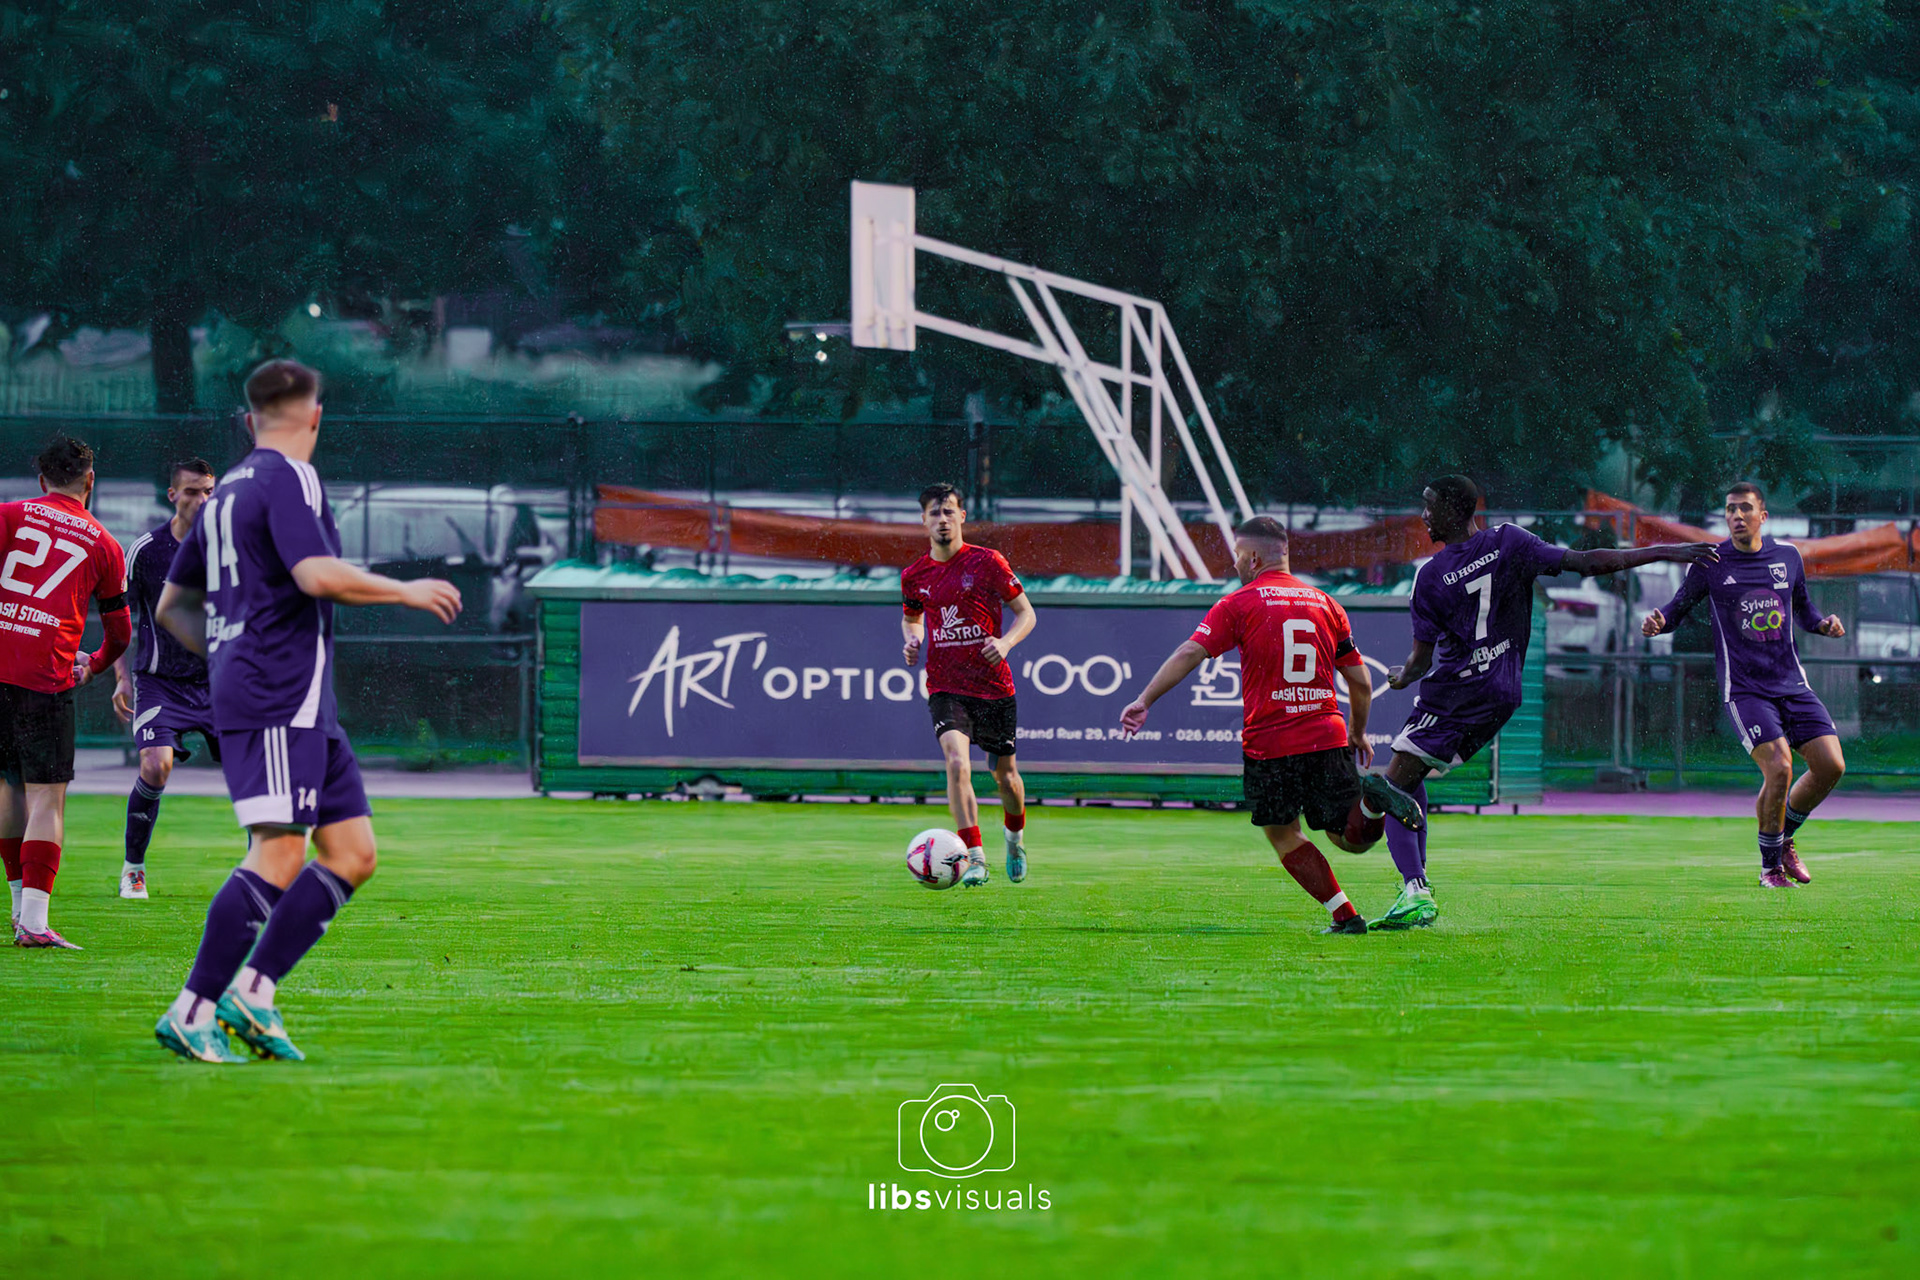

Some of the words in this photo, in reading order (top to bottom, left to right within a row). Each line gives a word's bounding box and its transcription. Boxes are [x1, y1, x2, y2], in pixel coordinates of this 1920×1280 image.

[204, 493, 240, 592] 14
[0, 526, 88, 599] 27
[1464, 572, 1492, 641] 7
[1740, 597, 1780, 614] Sylvain
[18, 605, 61, 627] STORES
[932, 624, 981, 641] KASTRO
[1282, 618, 1317, 684] 6
[1271, 686, 1296, 702] GASH
[1296, 686, 1333, 702] STORES
[142, 728, 155, 741] 16
[1015, 727, 1054, 740] Grand
[1056, 727, 1083, 740] Rue
[1749, 724, 1762, 739] 19
[299, 787, 317, 811] 14
